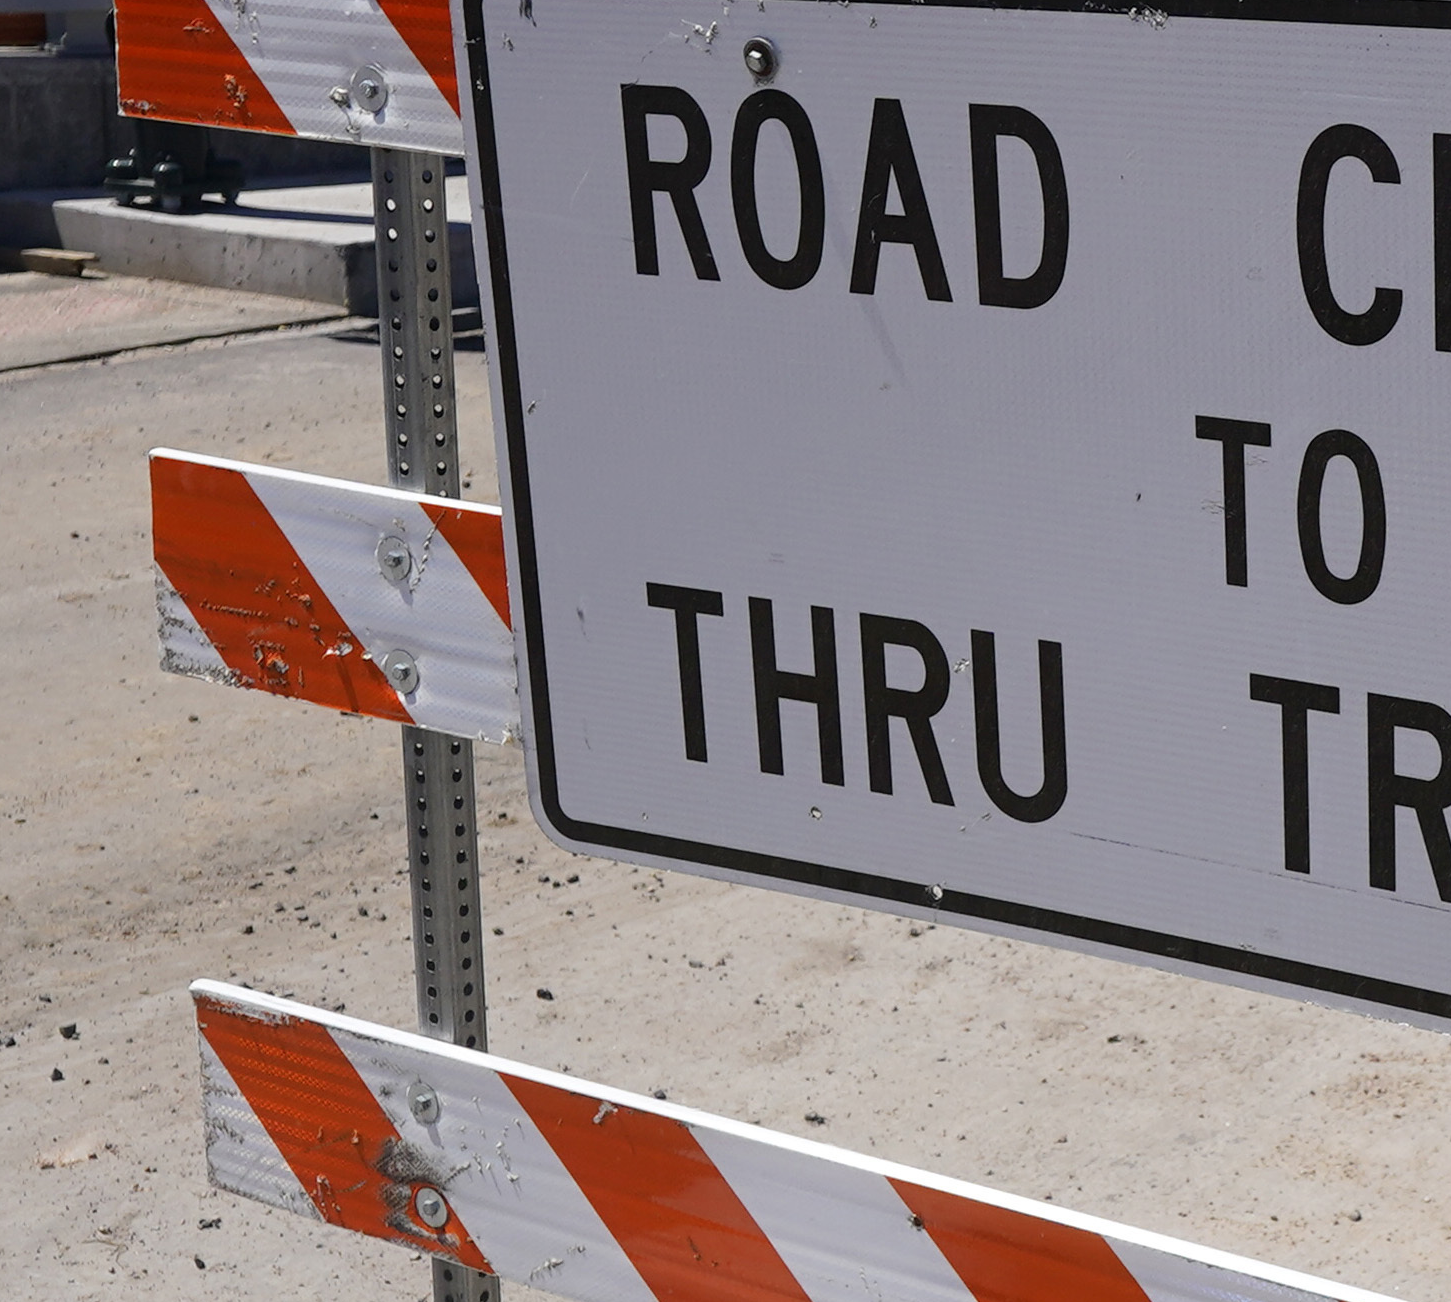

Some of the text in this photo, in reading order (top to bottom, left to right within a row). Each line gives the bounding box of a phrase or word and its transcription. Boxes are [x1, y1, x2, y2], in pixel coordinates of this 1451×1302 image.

[620, 83, 1069, 310] ROAD
[1194, 414, 1387, 606] TO
[645, 581, 1068, 824] THRU
